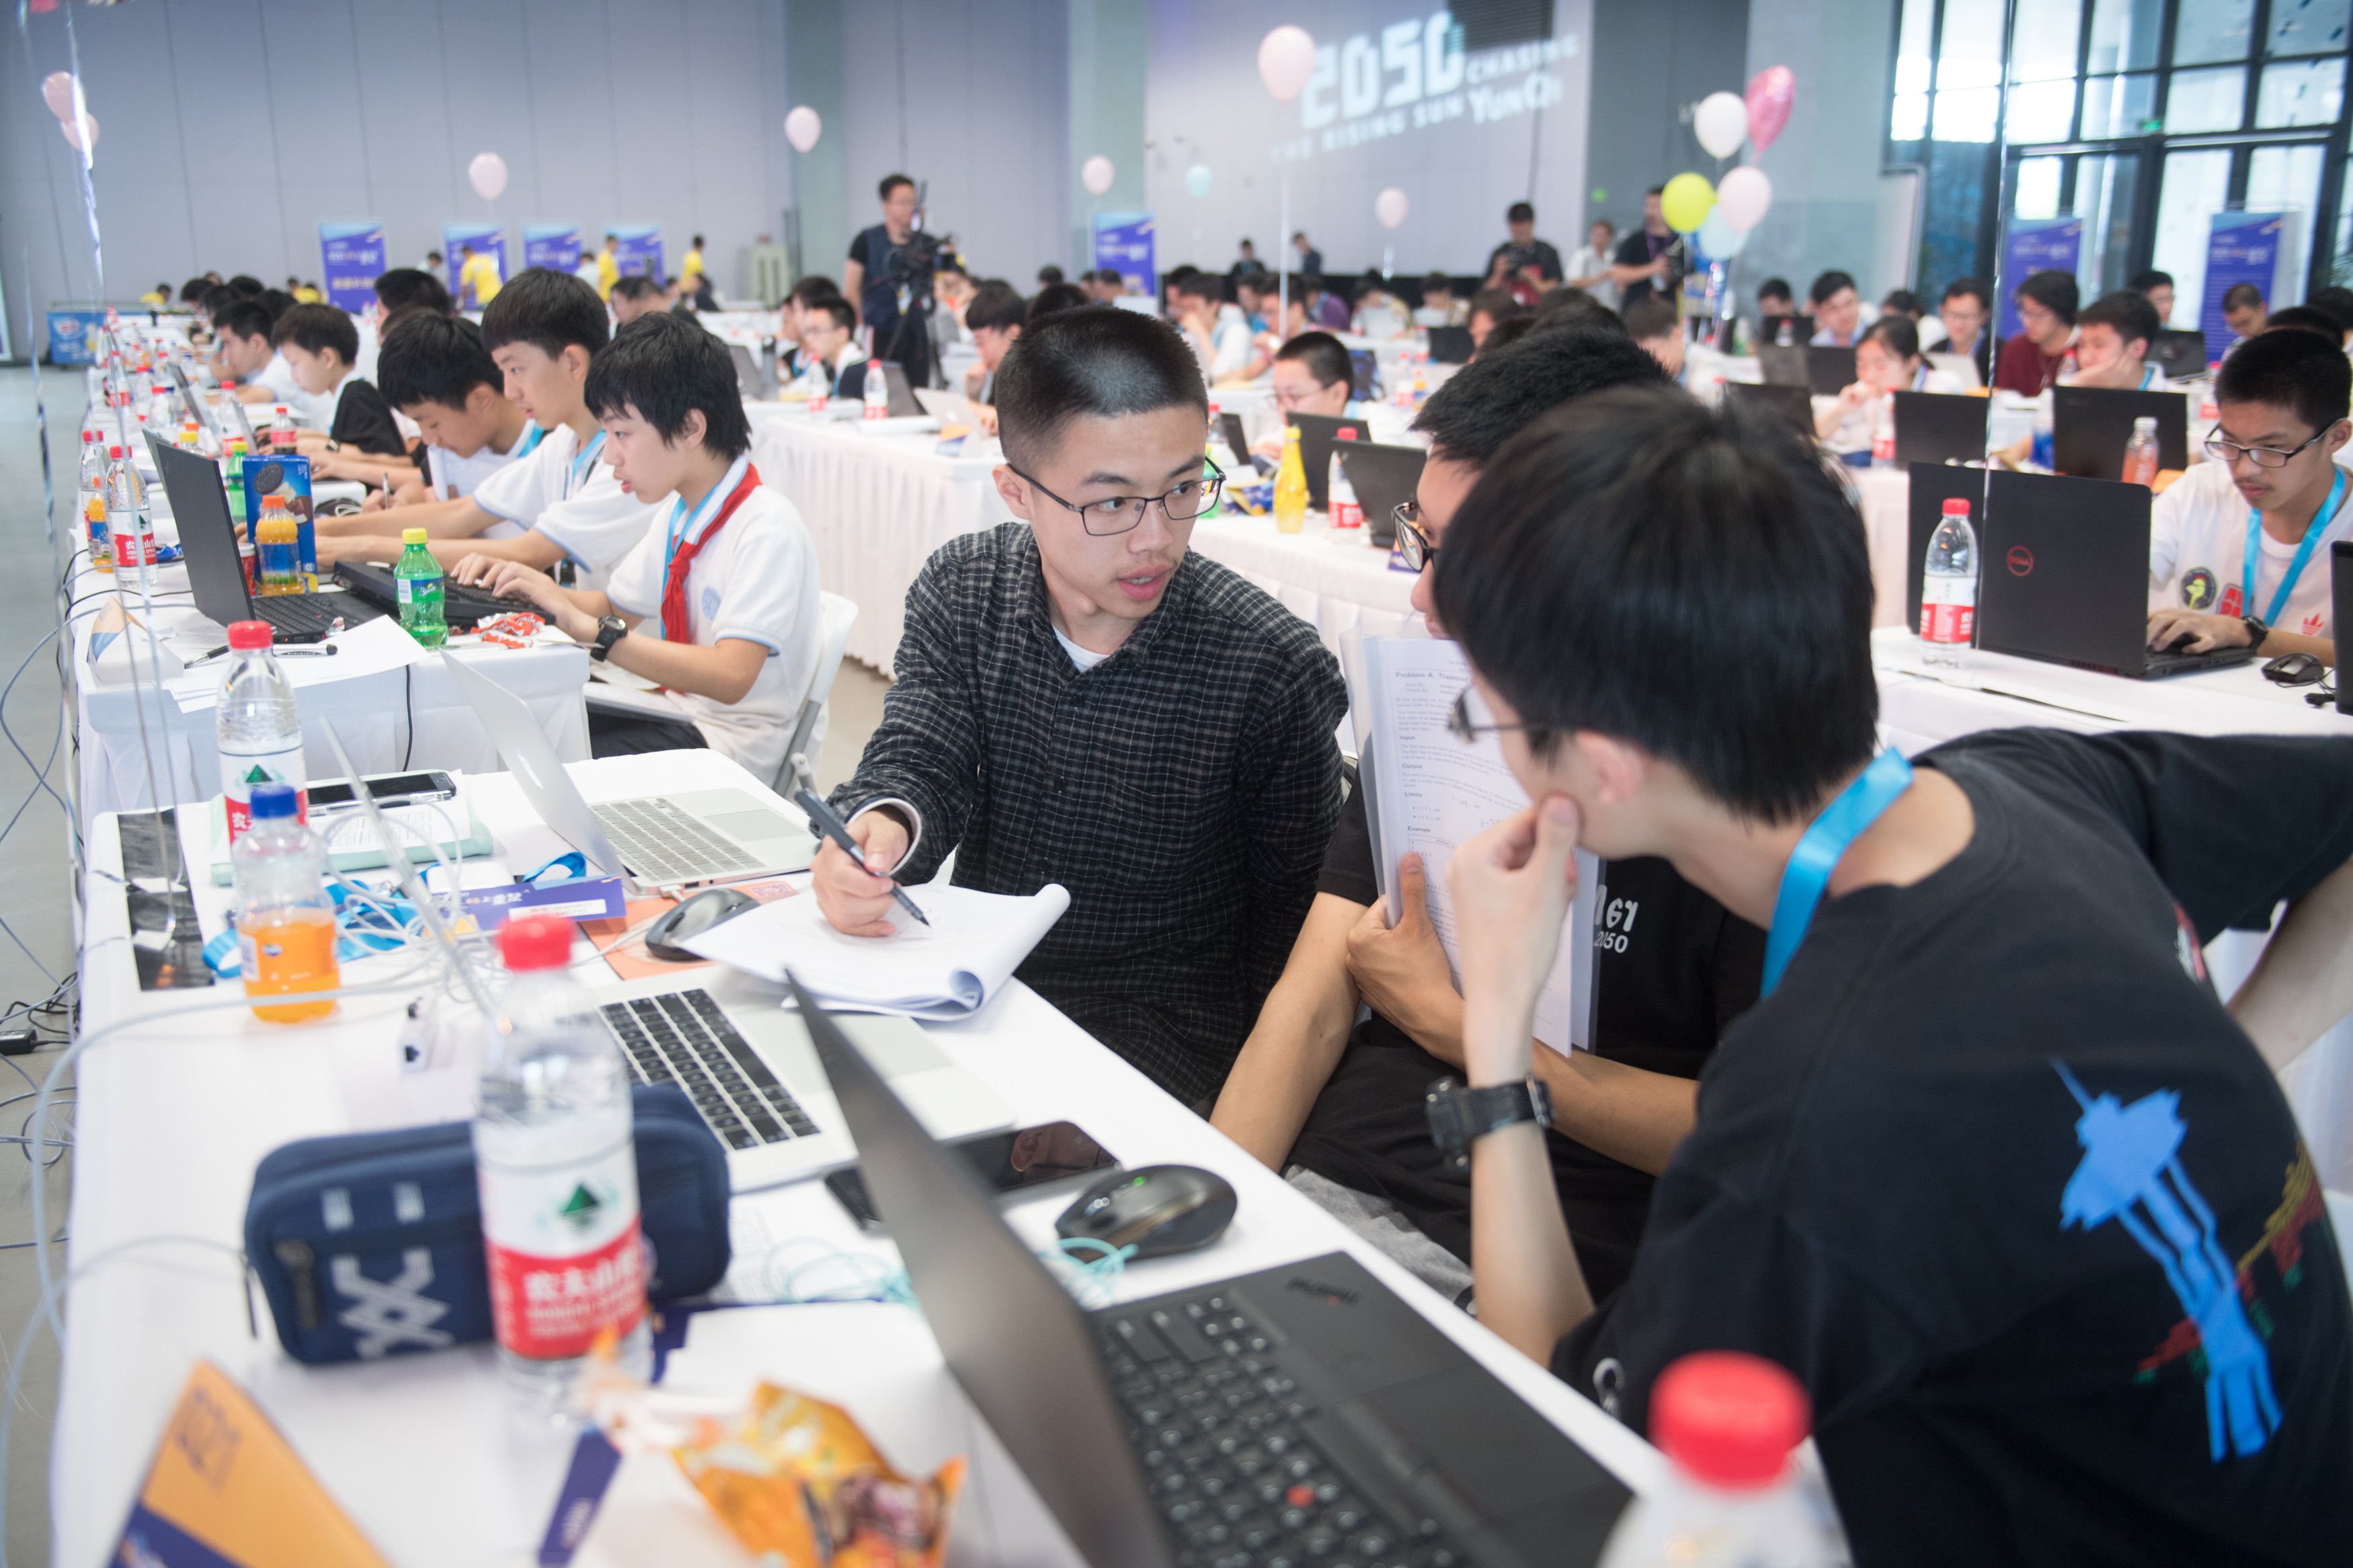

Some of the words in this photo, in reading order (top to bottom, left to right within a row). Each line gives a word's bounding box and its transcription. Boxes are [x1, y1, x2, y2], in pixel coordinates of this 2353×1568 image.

[1301, 10, 1465, 130] 2050
[1466, 33, 1580, 85] CHASING
[1271, 137, 1313, 165] THE
[1321, 111, 1406, 152] RISING
[1412, 95, 1464, 128] SUN
[1593, 930, 1628, 953] 2050
